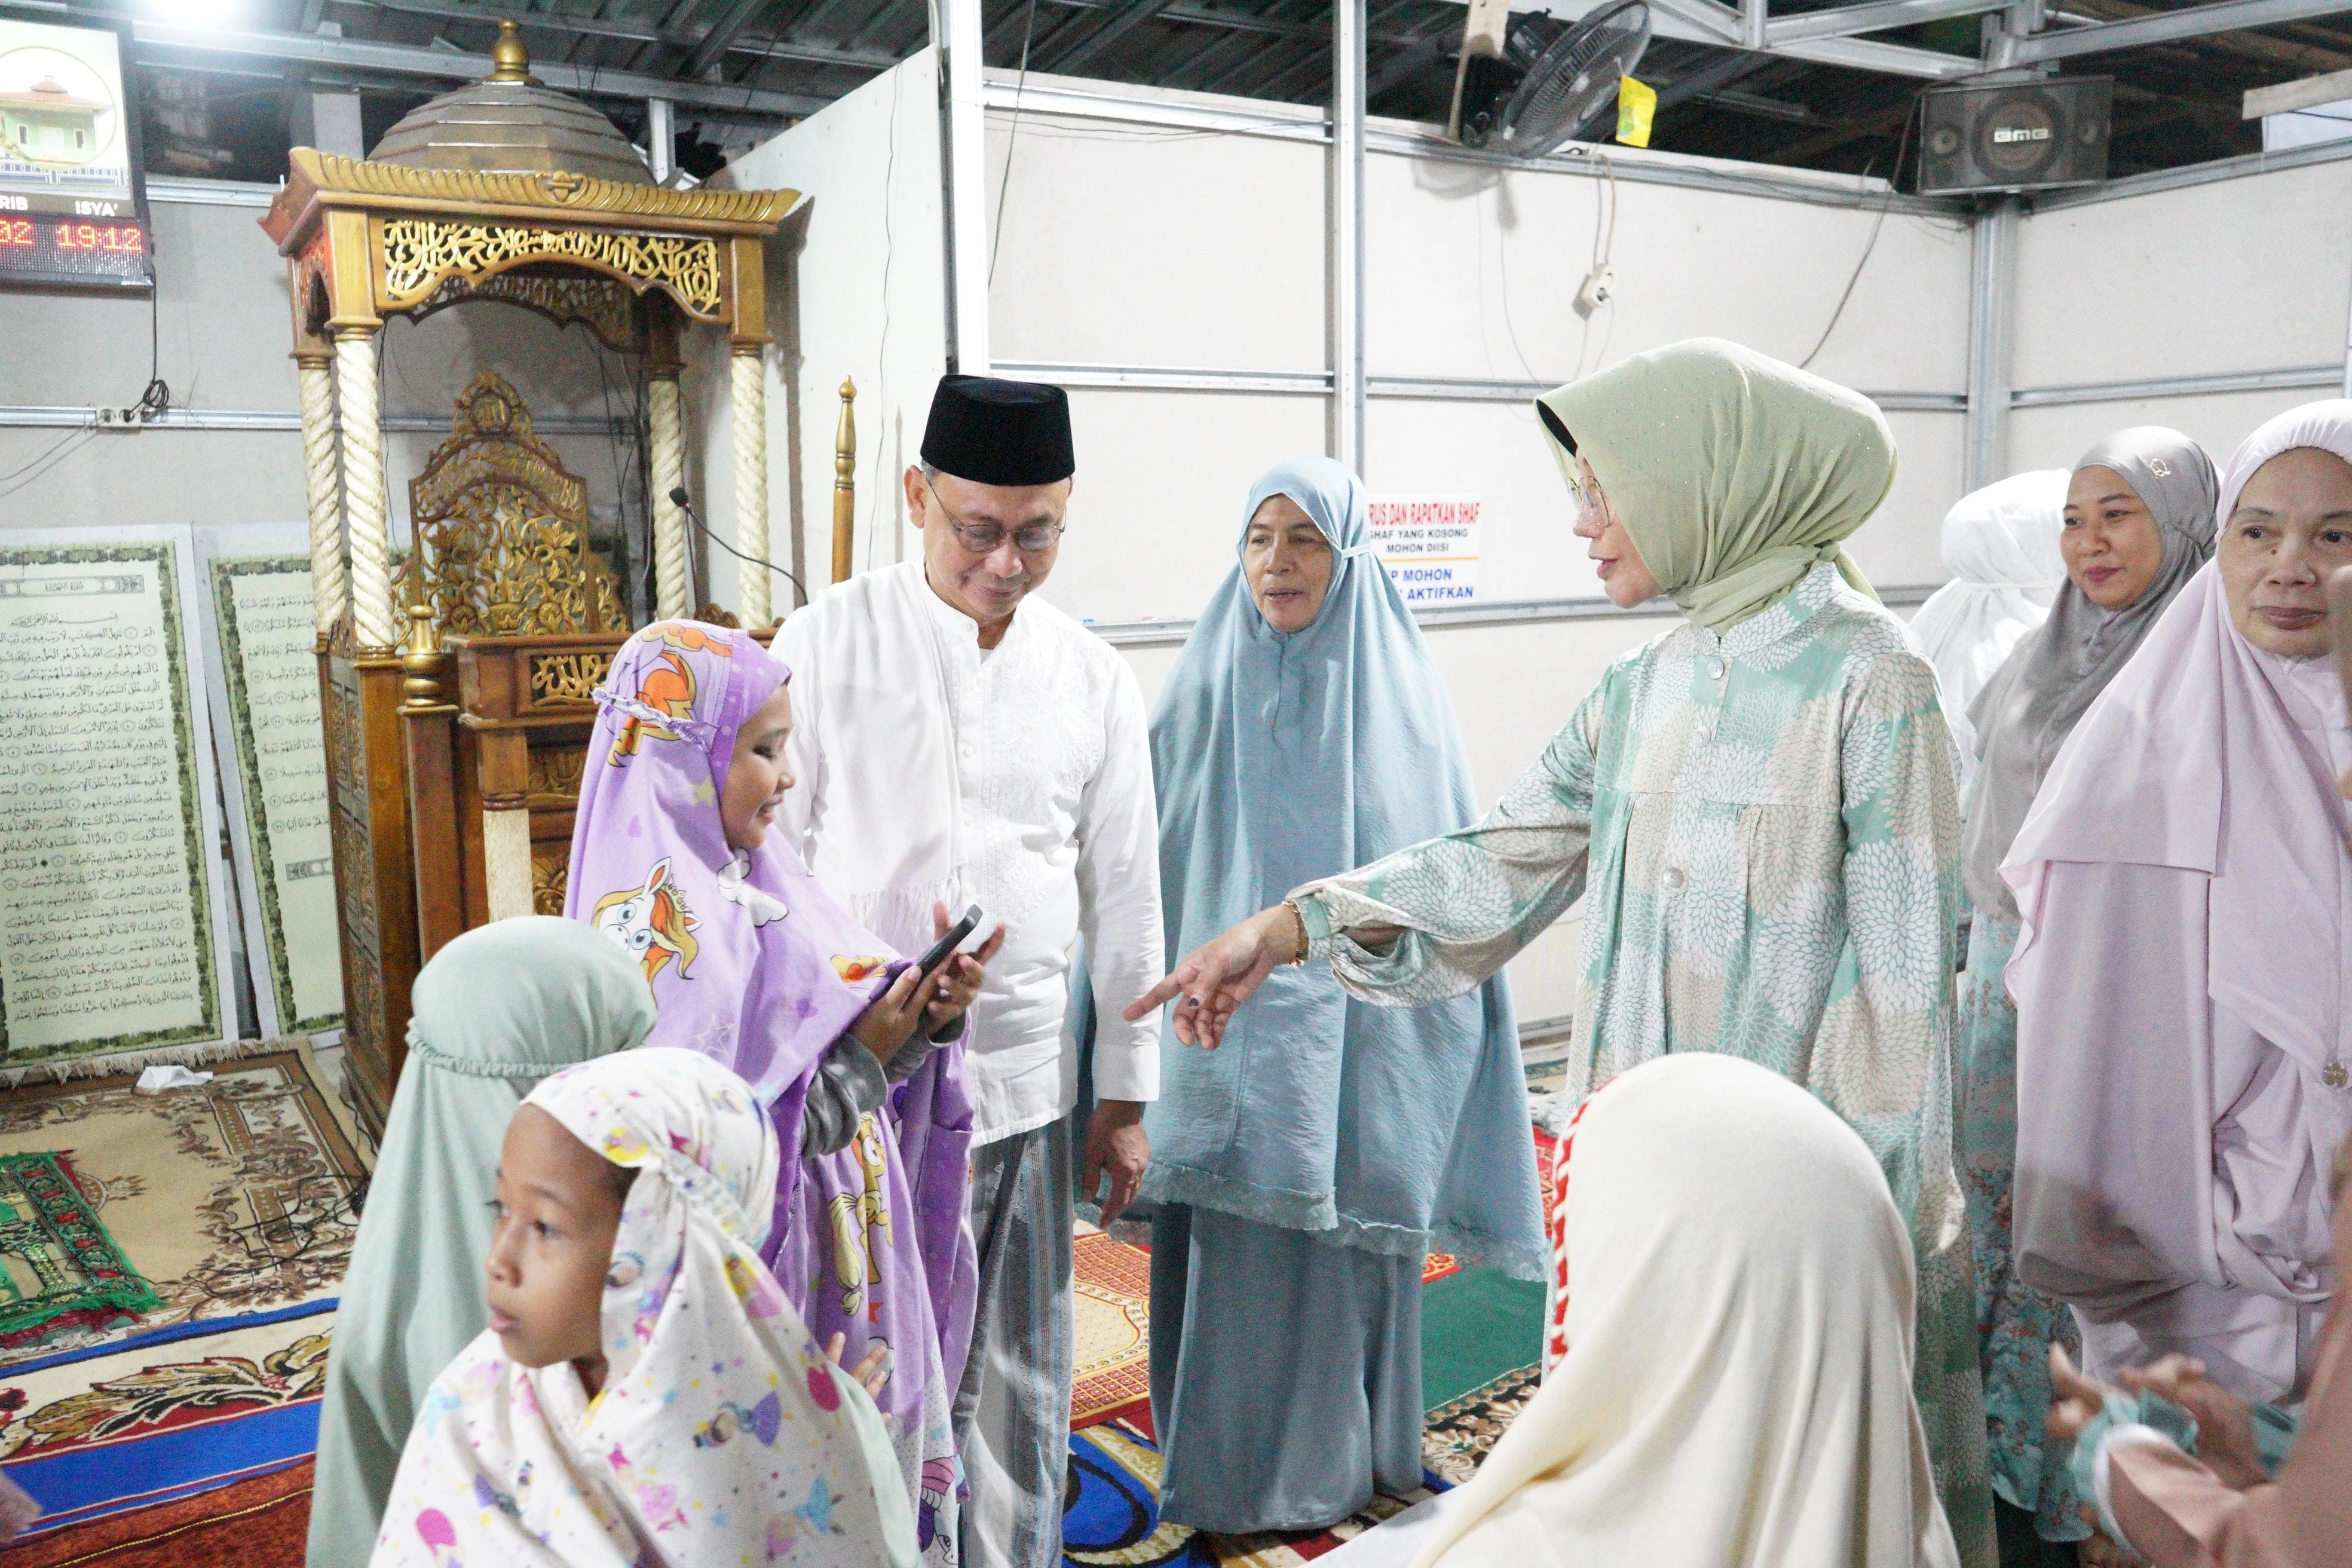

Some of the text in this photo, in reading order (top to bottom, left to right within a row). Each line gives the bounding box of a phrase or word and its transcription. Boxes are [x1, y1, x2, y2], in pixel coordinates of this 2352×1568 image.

[75, 201, 118, 216] ISYA'
[1389, 503, 1407, 525] DAN
[1410, 503, 1455, 525] RAPATKAN
[1458, 502, 1480, 524] SHAF
[1398, 529, 1424, 539] YANG
[1428, 528, 1468, 539] KOSONG
[1386, 543, 1449, 553] MOHON DIISI
[1403, 568, 1452, 581] MOHON
[1407, 586, 1474, 600] AKTIFKAN
